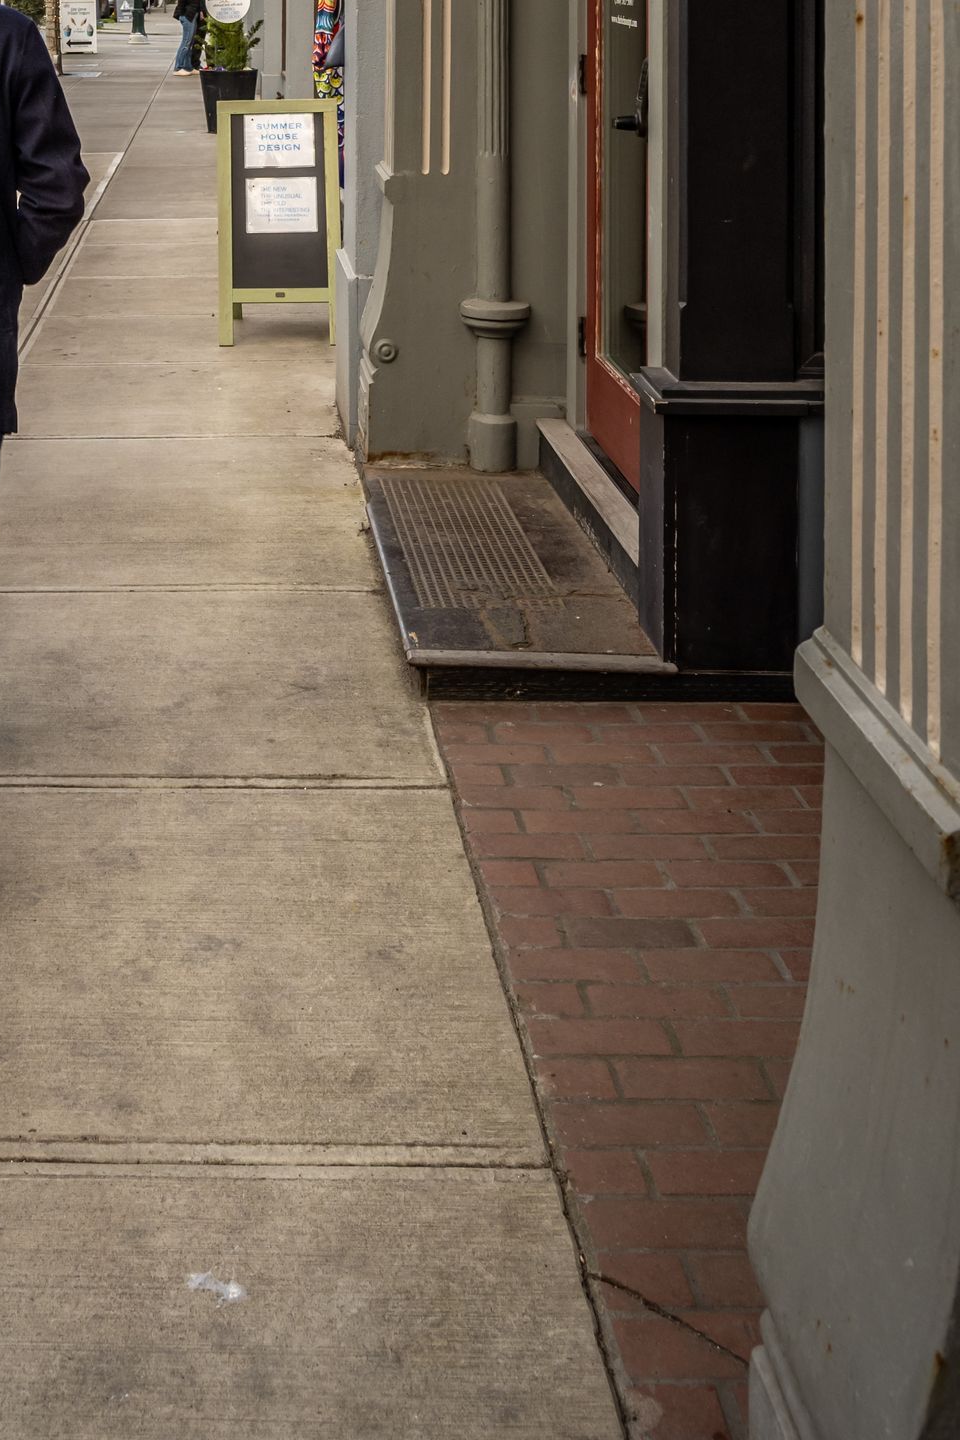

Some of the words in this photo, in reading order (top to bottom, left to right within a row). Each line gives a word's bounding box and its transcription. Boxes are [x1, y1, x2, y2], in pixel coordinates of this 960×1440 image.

[256, 122, 303, 130] SUMMER
[260, 133, 299, 141] HOUSE
[258, 143, 301, 152] DESIGN
